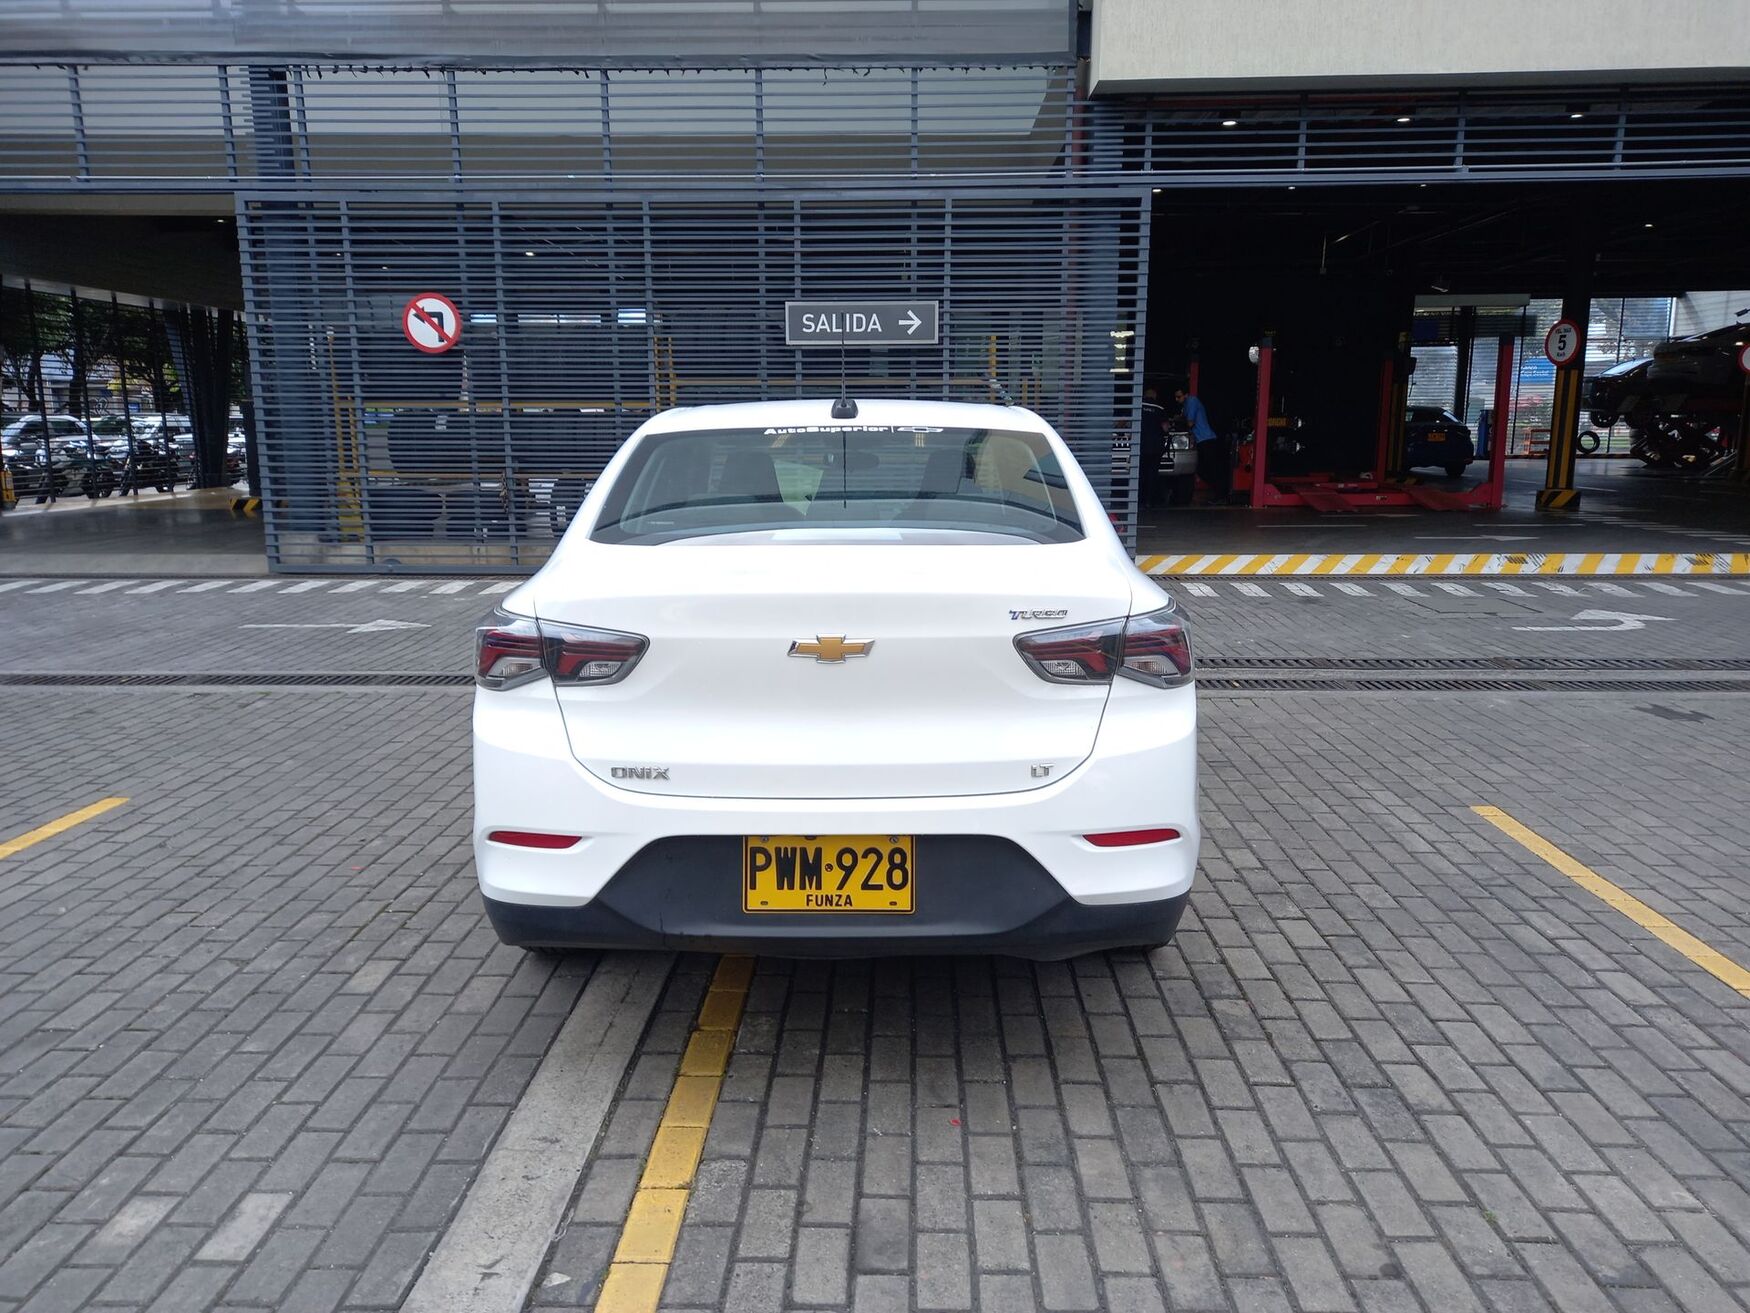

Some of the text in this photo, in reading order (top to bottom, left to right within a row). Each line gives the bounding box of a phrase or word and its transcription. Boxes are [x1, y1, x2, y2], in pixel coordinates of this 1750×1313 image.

[802, 313, 882, 333] SALIDA
[1558, 334, 1567, 351] 5
[763, 425, 888, 435] AutoSuperior
[611, 766, 671, 780] ONIX
[1031, 763, 1055, 777] LT
[749, 846, 909, 891] PWM 928
[806, 893, 853, 907] FUNZA
